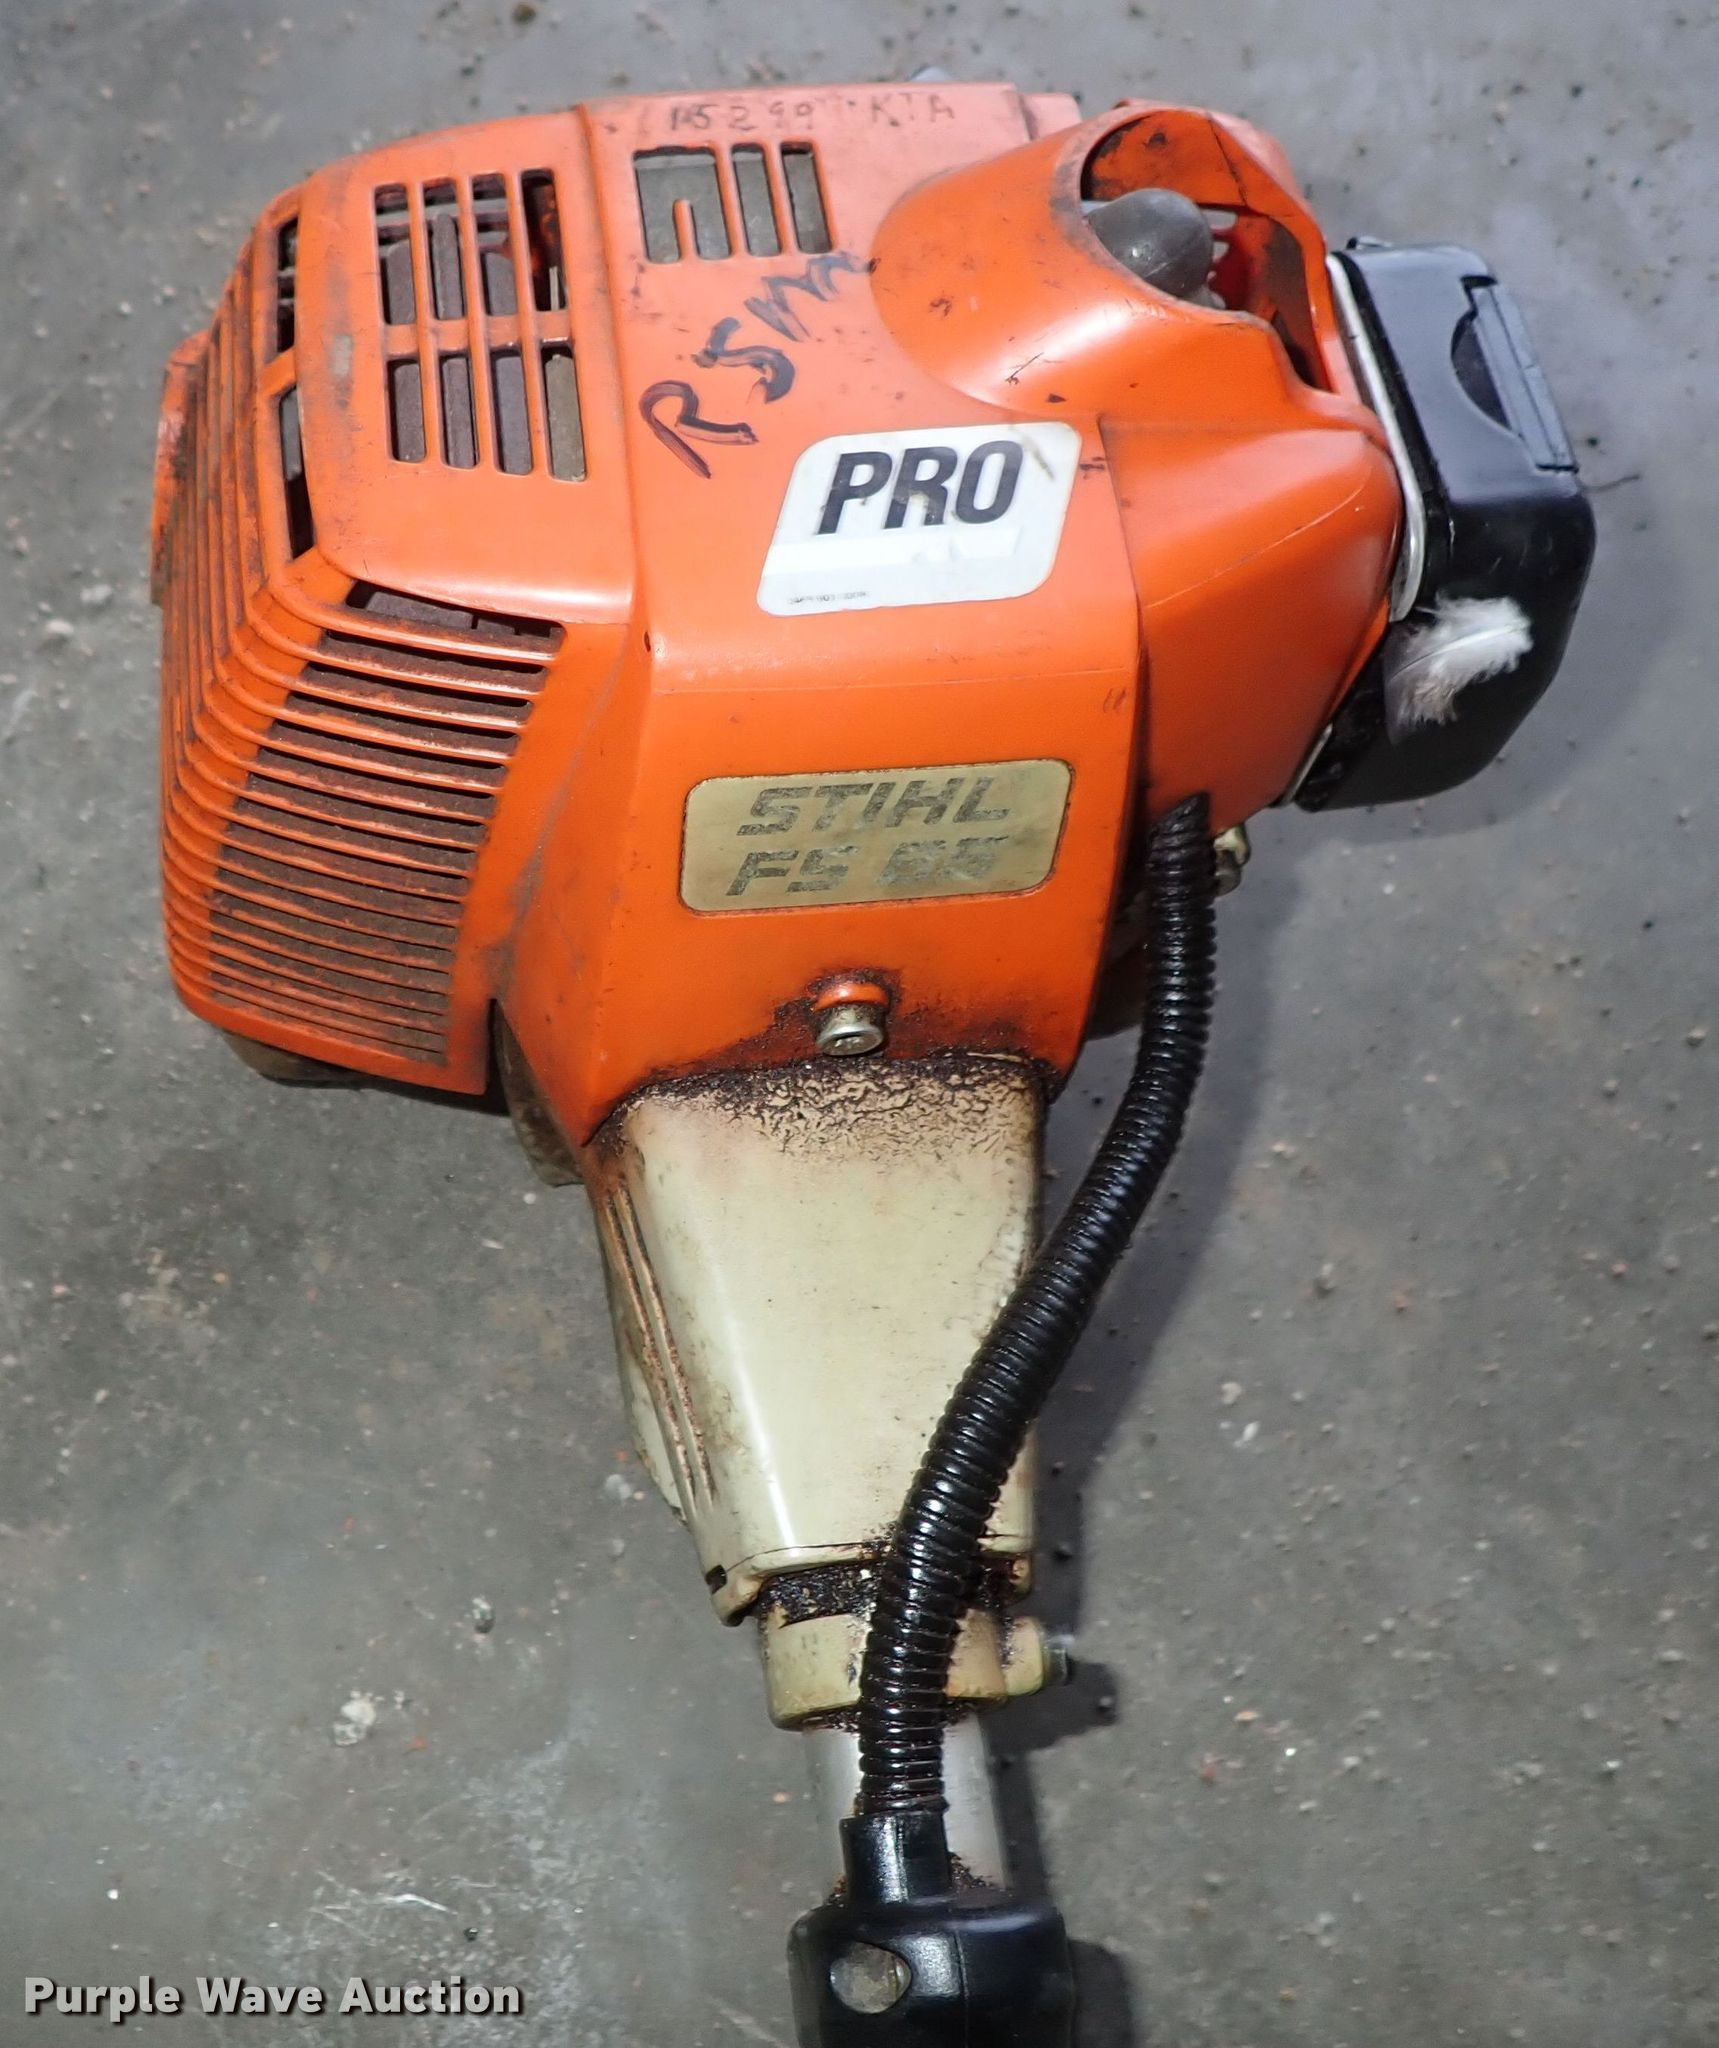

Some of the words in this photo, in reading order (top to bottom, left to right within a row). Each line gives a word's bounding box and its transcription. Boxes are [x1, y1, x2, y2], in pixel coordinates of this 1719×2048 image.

[813, 440, 1024, 535] PRO
[736, 777, 1010, 836] STIHL
[725, 846, 859, 896] FS
